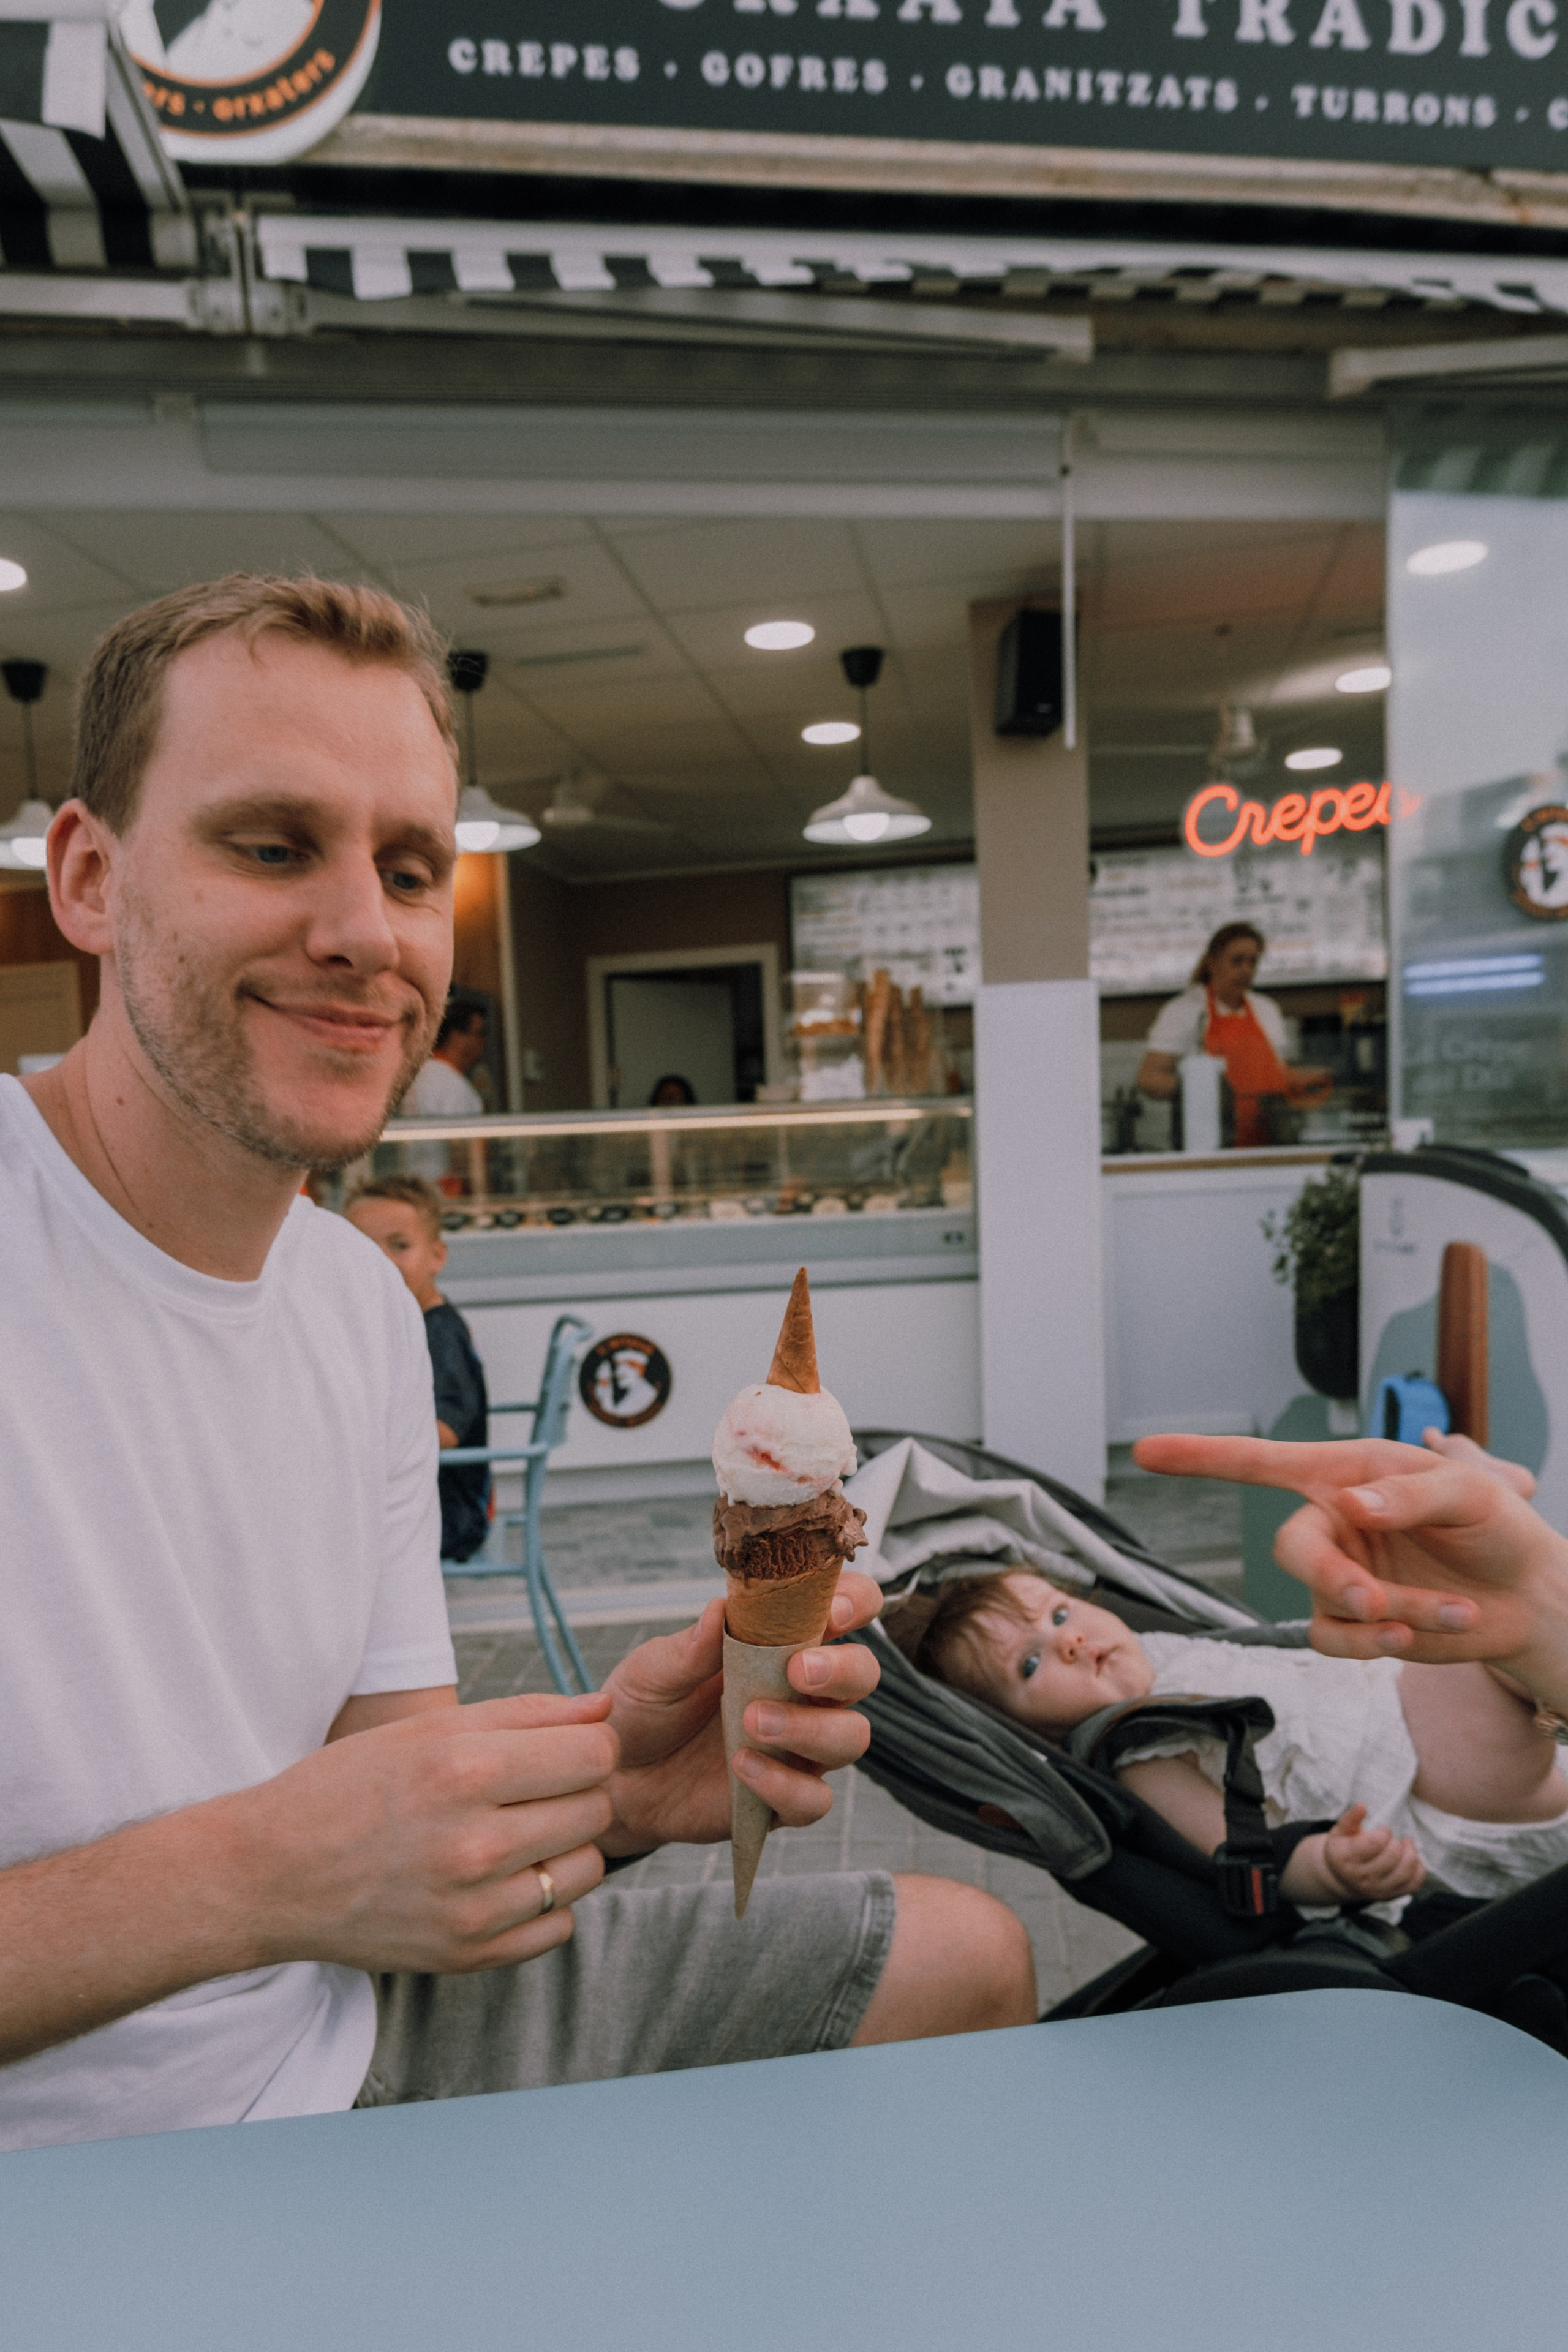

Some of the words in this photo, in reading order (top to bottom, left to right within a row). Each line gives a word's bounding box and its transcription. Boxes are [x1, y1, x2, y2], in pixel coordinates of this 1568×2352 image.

[447, 37, 641, 81] CREPES
[700, 50, 888, 94] GOFRES
[944, 63, 1238, 113] GRANITZATS
[1290, 83, 1497, 128] TURRONS
